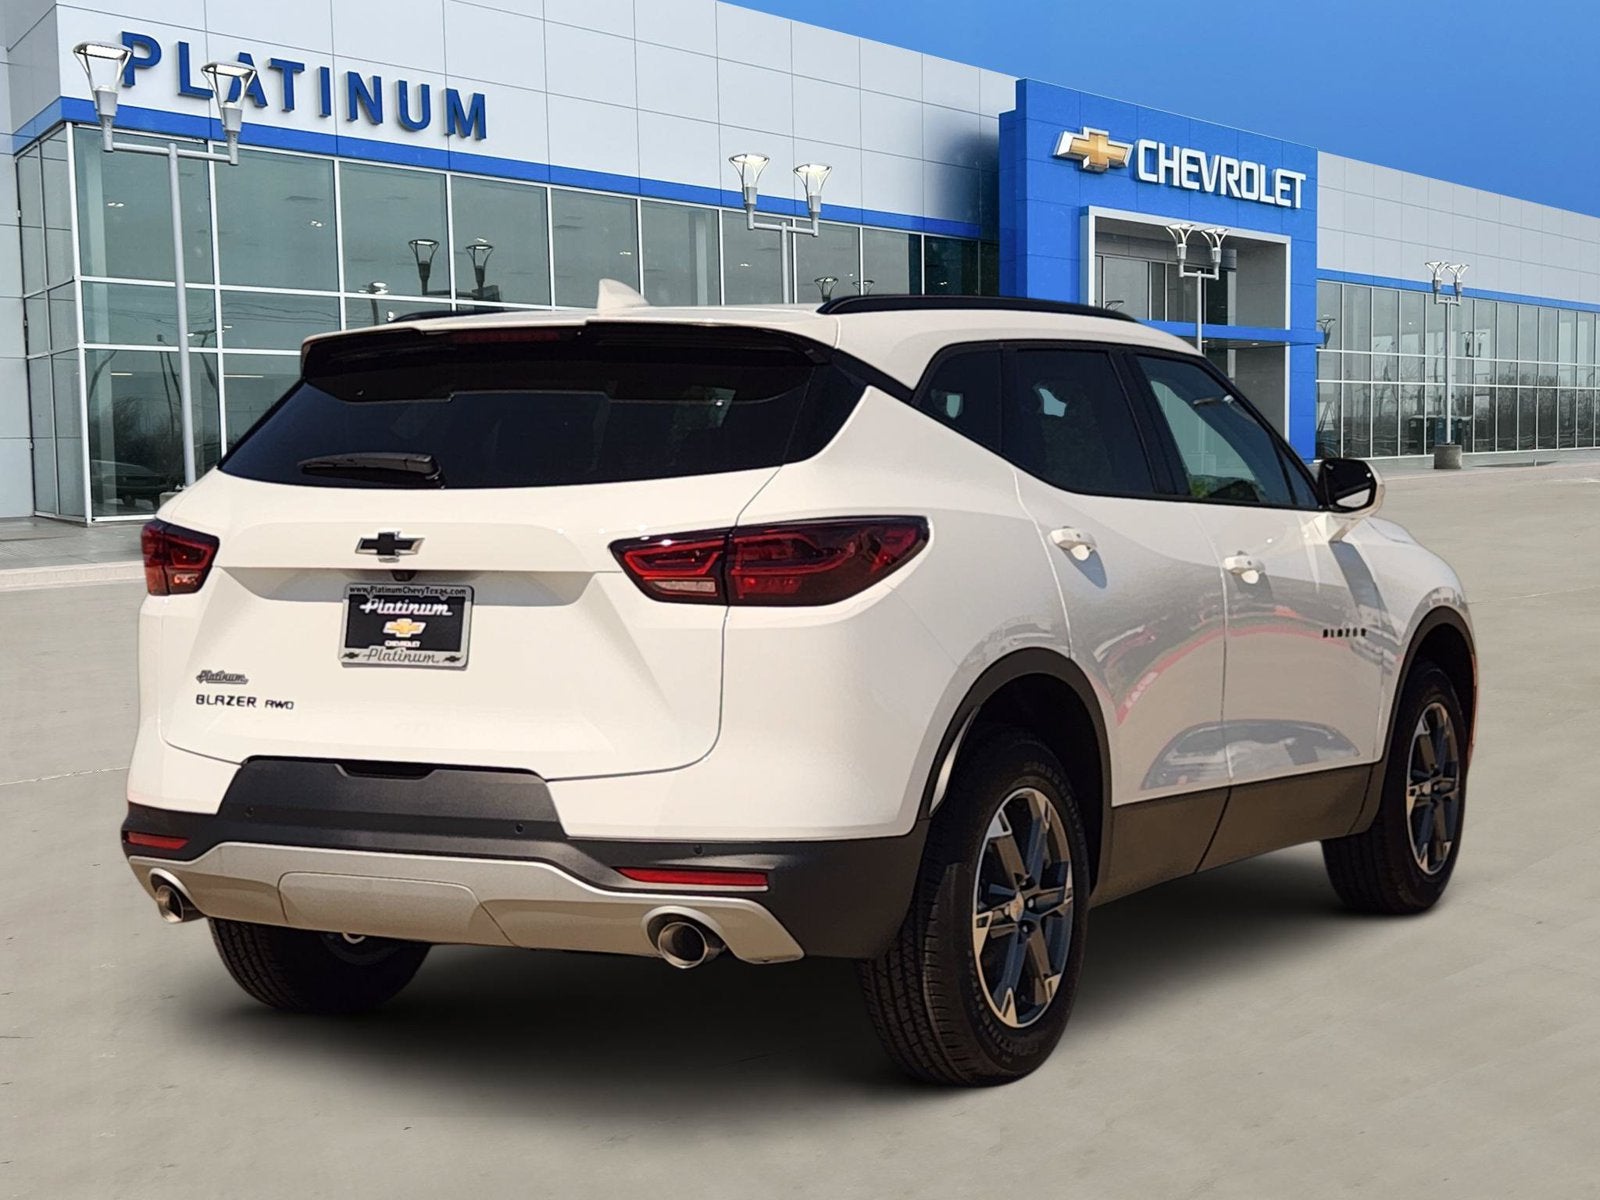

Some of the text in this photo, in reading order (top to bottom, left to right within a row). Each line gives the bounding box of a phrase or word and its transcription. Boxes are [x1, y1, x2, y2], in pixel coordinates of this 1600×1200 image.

[120, 31, 487, 141] PLATINUM
[1137, 138, 1307, 209] CHEVROLET
[349, 585, 467, 597] www.PlatinumChevyTexas.com
[359, 598, 453, 616] Platinum
[362, 647, 441, 664] Platinum
[195, 693, 258, 708] BLAZER
